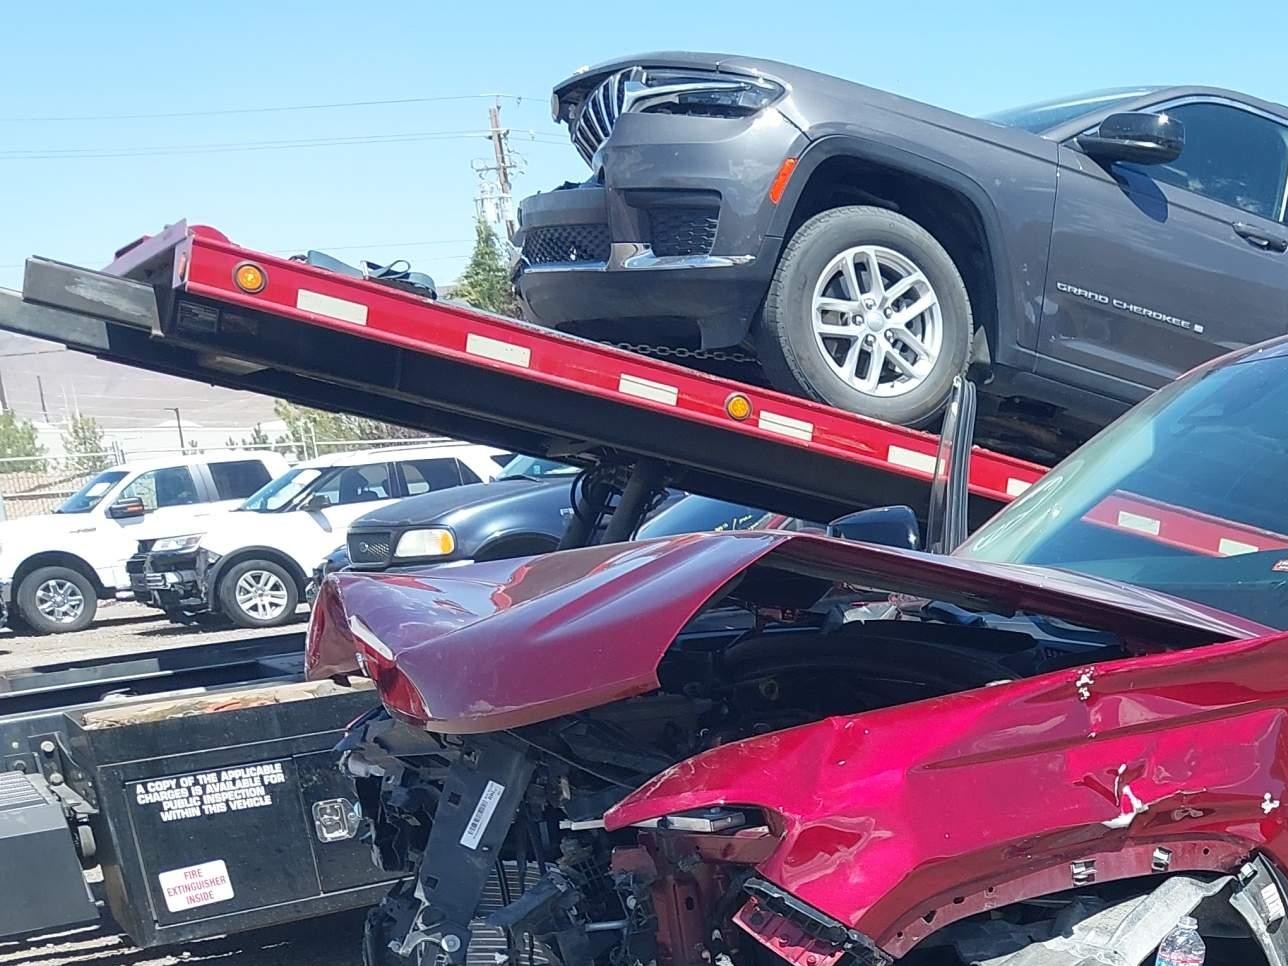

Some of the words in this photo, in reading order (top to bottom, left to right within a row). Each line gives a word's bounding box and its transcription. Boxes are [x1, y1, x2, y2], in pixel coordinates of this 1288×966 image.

[1056, 281, 1109, 304] GRAND
[1112, 298, 1191, 329] CHEROKEE
[136, 784, 146, 795] A
[147, 779, 177, 794] COPY
[180, 776, 195, 789] OF
[197, 773, 218, 785] THE
[220, 763, 283, 782] APPLICABLE
[136, 788, 189, 805] CHARGES
[191, 785, 203, 796] IS
[205, 777, 262, 795] AVAILABLE
[263, 773, 286, 785] FOR
[160, 806, 201, 822] WITHIN
[202, 802, 227, 815] THIS
[228, 795, 273, 811] VEHICLE
[162, 797, 201, 811] PUBLIC
[202, 786, 266, 804] INSPECTION
[166, 875, 226, 897] EXTINGUISHER
[183, 868, 204, 880] FIRE
[186, 890, 215, 905] INSIDE
